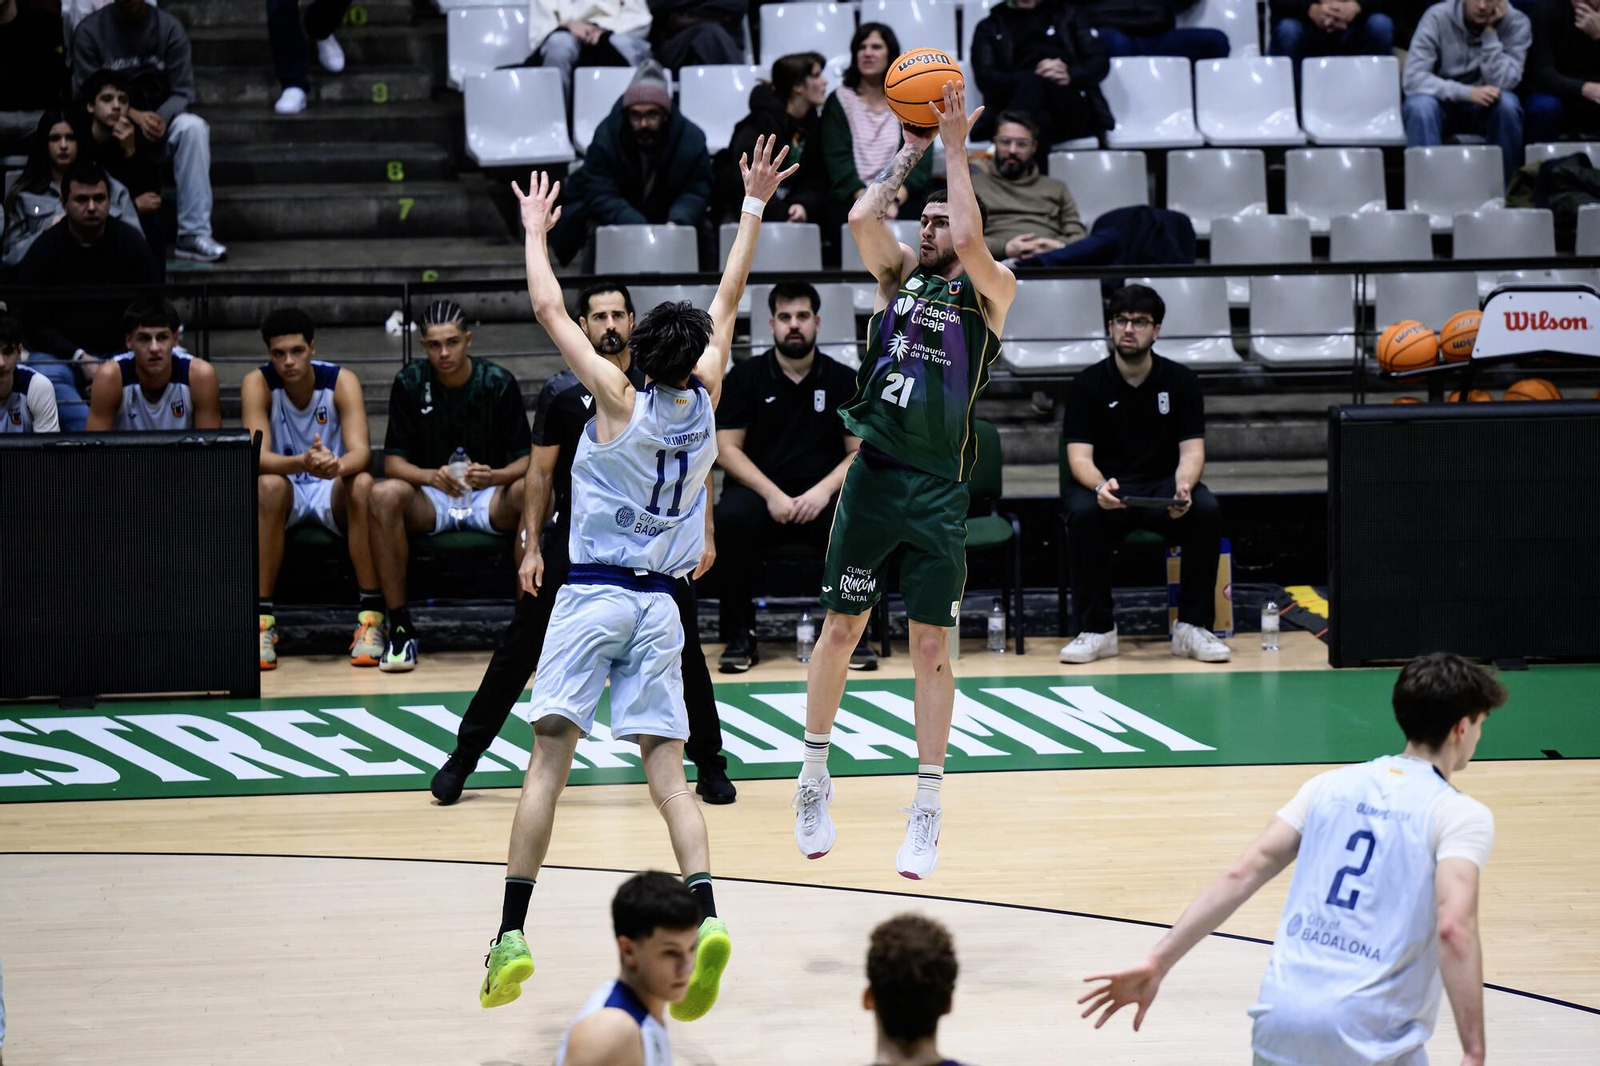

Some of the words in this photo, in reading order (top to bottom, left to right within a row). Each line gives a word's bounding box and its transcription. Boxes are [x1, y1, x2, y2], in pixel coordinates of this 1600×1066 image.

[897, 54, 952, 72] Wilson
[387, 160, 404, 181] 8
[397, 197, 414, 220] 7
[1503, 311, 1589, 331] Wilson
[910, 350, 921, 358] de
[922, 352, 930, 361] la
[931, 355, 952, 367] Torre
[912, 343, 946, 358] Alhaurín
[880, 372, 915, 408] 21
[645, 449, 689, 517] 11
[639, 512, 657, 525] City
[658, 520, 669, 528] of
[841, 592, 868, 602] DENTAL
[1325, 830, 1376, 910] 2
[1301, 928, 1381, 962] BADALONA
